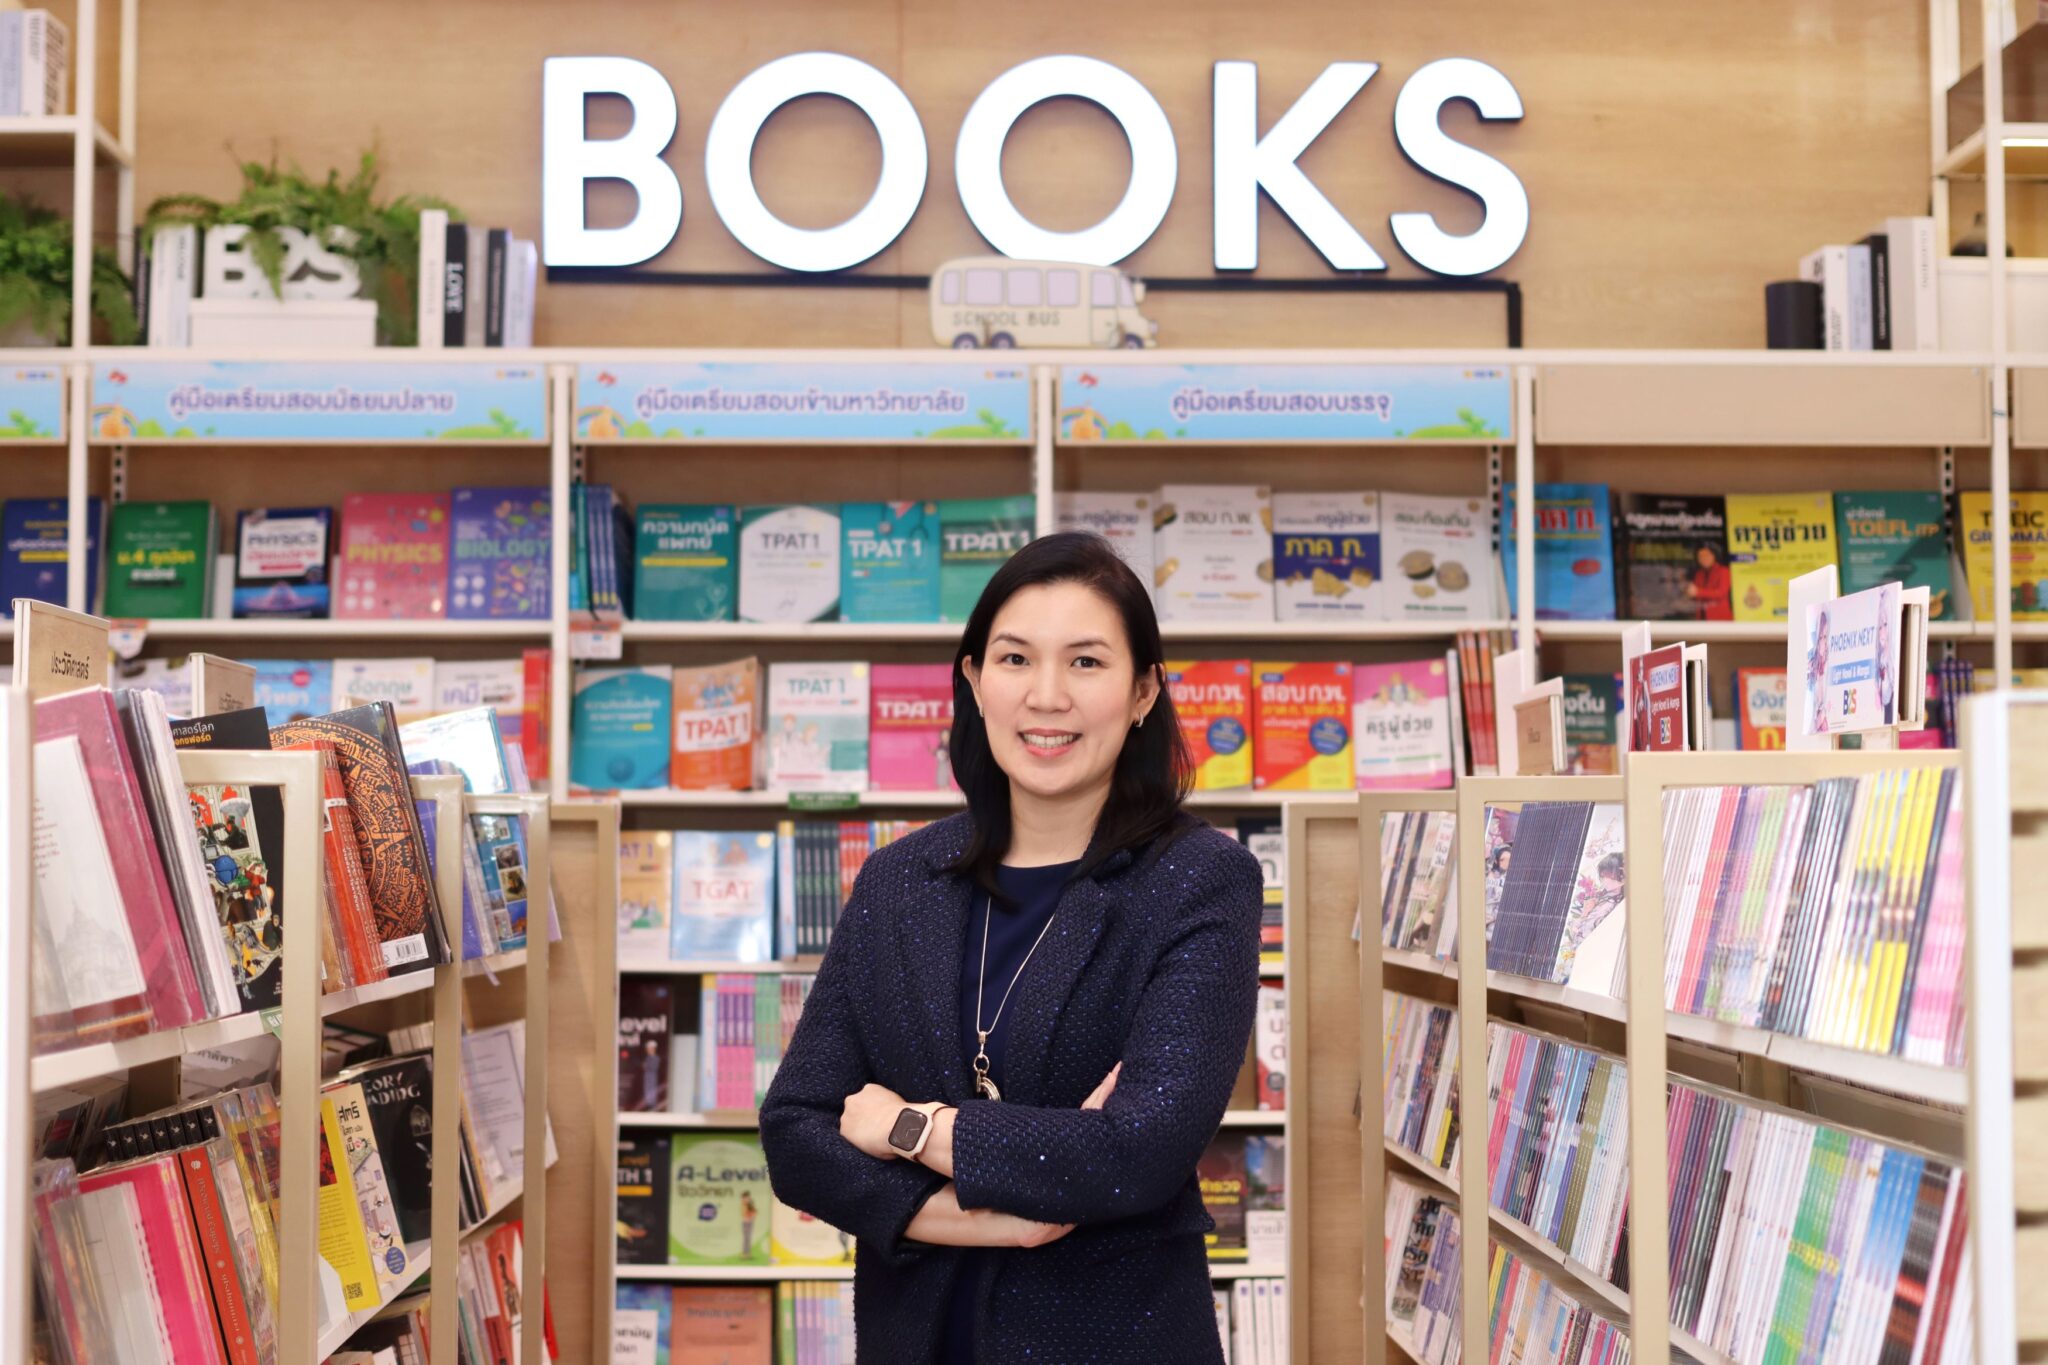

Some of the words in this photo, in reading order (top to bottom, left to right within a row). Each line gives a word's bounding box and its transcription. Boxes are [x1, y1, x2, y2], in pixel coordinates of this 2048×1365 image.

[543, 52, 1530, 276] BOOKS
[446, 262, 463, 313] LOVE
[953, 312, 1019, 327] SCHOOL
[1027, 312, 1061, 327] BUS
[636, 387, 966, 418] คู่มือเตรียมสอบเข้ามหาวิทยาลัย
[1172, 388, 1391, 420] คู่มือเตรียมสอบบรรจุ
[1846, 519, 1914, 538] TOEFL
[1979, 510, 2044, 528] TEIC
[761, 532, 807, 550] TPAT
[812, 532, 821, 549] 1
[944, 531, 1016, 552] TPAT
[1734, 517, 1827, 550] ครูผู้ช่วย
[1969, 529, 2048, 544] GRMMA
[347, 542, 443, 564] PHYSICS
[455, 538, 551, 561] BIOLOGY
[847, 539, 906, 559] TPAT
[911, 539, 923, 558] 1
[1284, 537, 1334, 557] ภาค
[1341, 537, 1366, 557] ก.
[1858, 625, 1876, 647] NEXT
[51, 652, 90, 680] ประวัติศาสตร์
[786, 678, 833, 695] TPAT
[878, 700, 943, 719] TPAT
[172, 721, 215, 737] ศาสตร์โลก
[684, 715, 738, 741] TPAT
[1366, 712, 1434, 741] ครูผู้ช่วย
[174, 733, 212, 746] อกซฟอร์ด
[691, 880, 754, 900] TGAT
[619, 1014, 668, 1033] evel
[676, 1165, 768, 1182] A-Level
